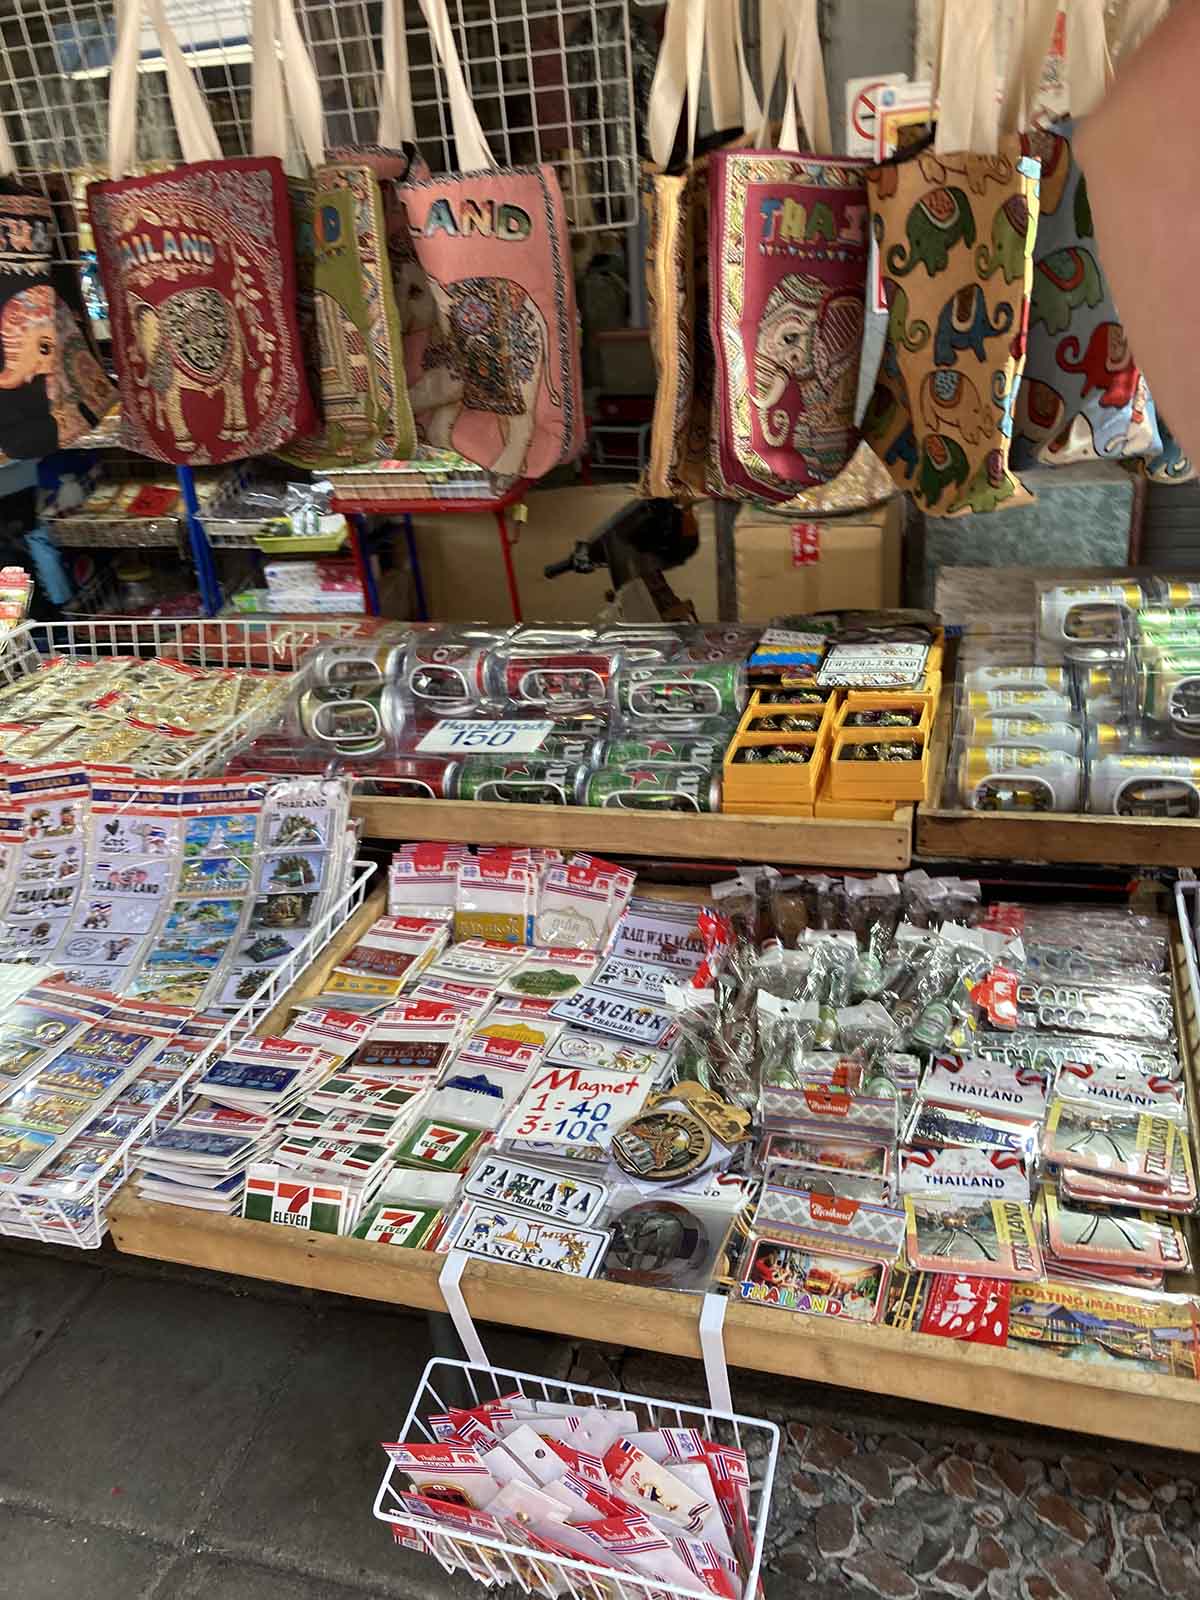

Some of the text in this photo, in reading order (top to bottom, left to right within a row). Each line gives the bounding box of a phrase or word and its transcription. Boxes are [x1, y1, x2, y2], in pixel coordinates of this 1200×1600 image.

[450, 730, 516, 747] 150
[276, 799, 328, 810] THAILAND
[565, 993, 667, 1030] BANGKOK
[592, 1016, 636, 1034] THAILAND
[531, 1069, 640, 1100] Magnet
[949, 1081, 1024, 1104] THAILAND
[428, 1127, 460, 1145] 7
[478, 1165, 591, 1212] PATTAYA
[924, 1175, 1006, 1189] THAILAND
[278, 1183, 310, 1213] 7
[511, 1194, 553, 1213] THAILAND
[382, 1211, 416, 1227] 7
[463, 1238, 566, 1271] BANGKOK
[740, 1280, 842, 1315] THAILAND
